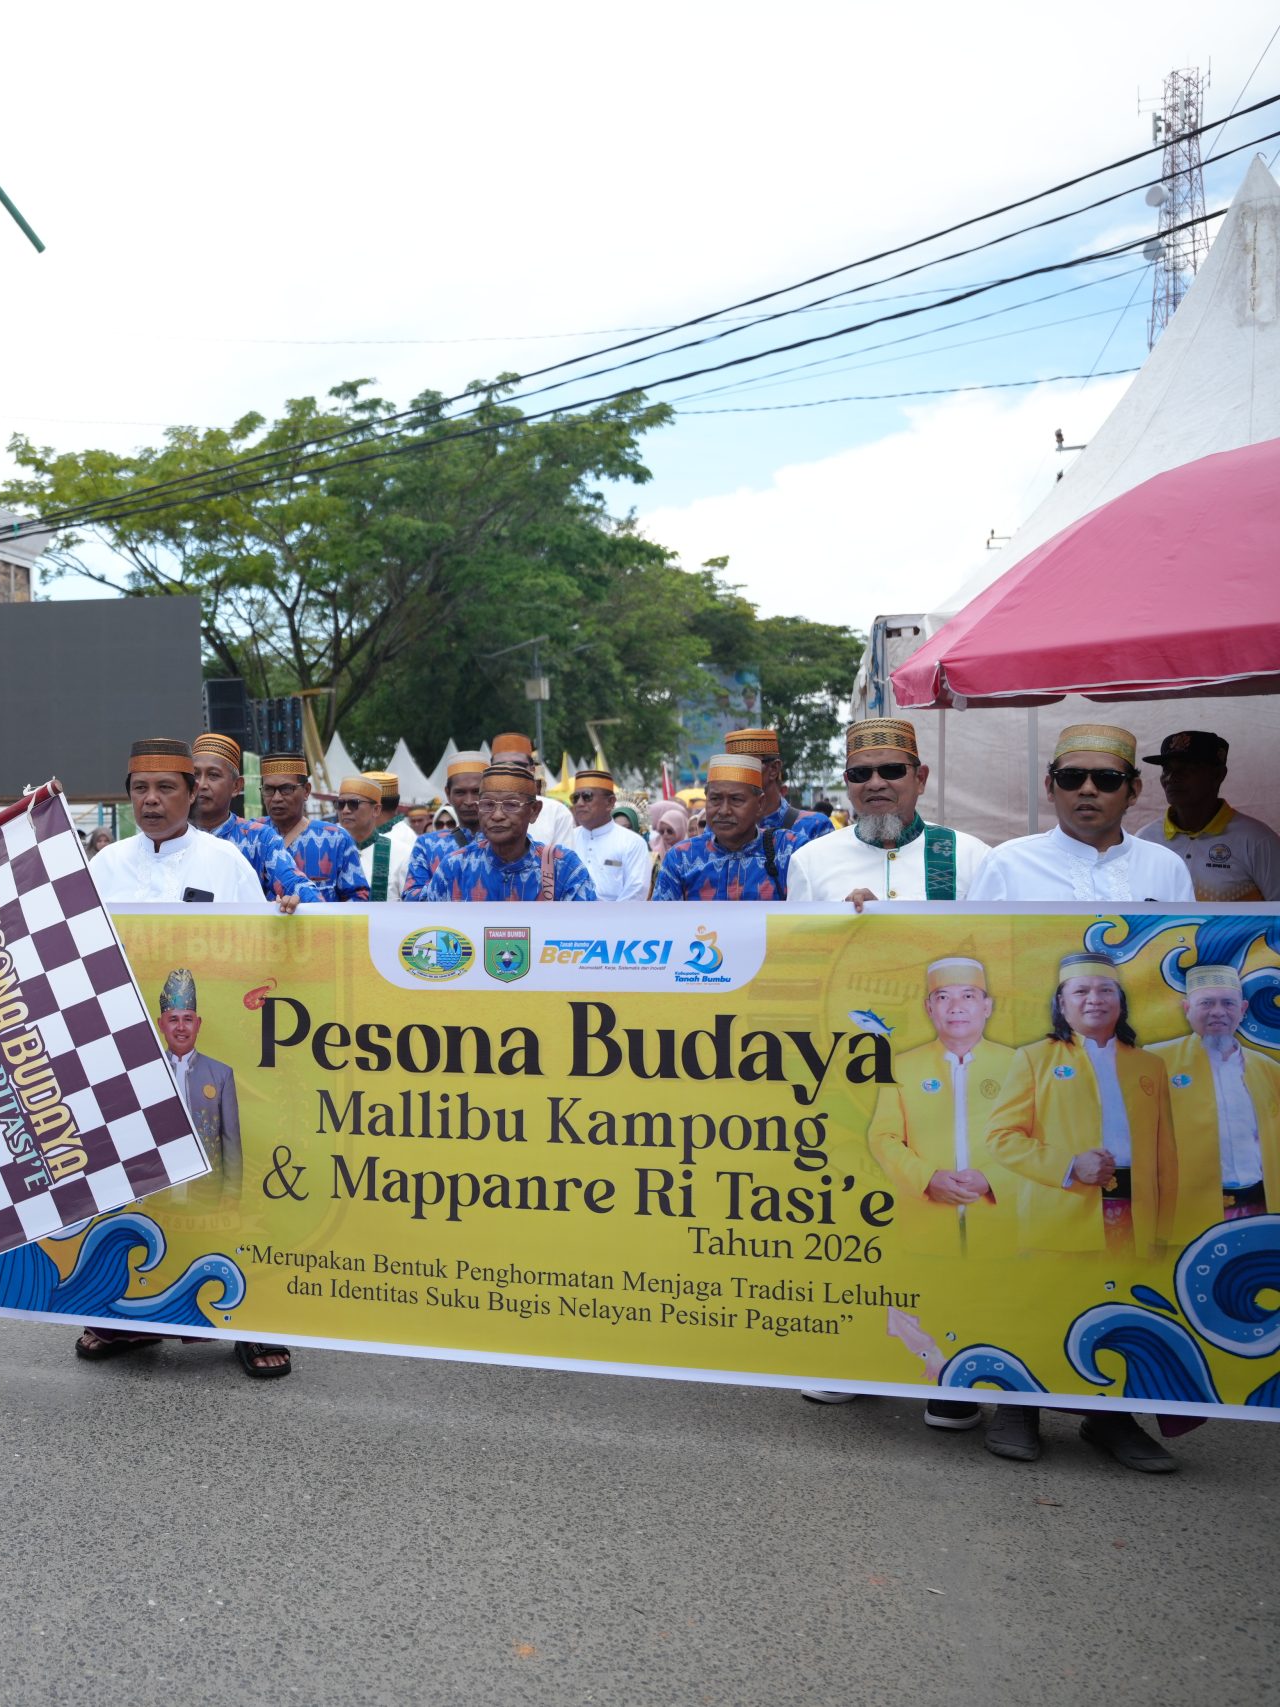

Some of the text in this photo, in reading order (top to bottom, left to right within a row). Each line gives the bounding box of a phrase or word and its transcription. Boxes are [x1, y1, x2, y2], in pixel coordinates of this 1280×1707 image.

[543, 870, 554, 901] OVE
[257, 997, 898, 1106] Pesona Budaya
[1, 1024, 88, 1182] BUDAYA
[315, 1088, 829, 1173] Mallibu Kampong
[262, 1145, 309, 1202] &
[330, 1154, 616, 1222] Mappanre
[633, 1167, 697, 1218] Ri
[687, 1226, 883, 1264] Tahun 2026
[286, 1275, 323, 1297] dan
[330, 1278, 419, 1305] Identitas
[425, 1286, 480, 1310] Suku
[487, 1291, 551, 1320] Bugis
[558, 1296, 652, 1326] Nelayan
[660, 1303, 736, 1329] Pesisir
[373, 1253, 448, 1279] Bentuk
[455, 1259, 615, 1290] Penghormatan
[622, 1270, 722, 1301] Menjaga
[730, 1276, 814, 1303] Tradisi
[823, 1281, 921, 1309] Leluhur
